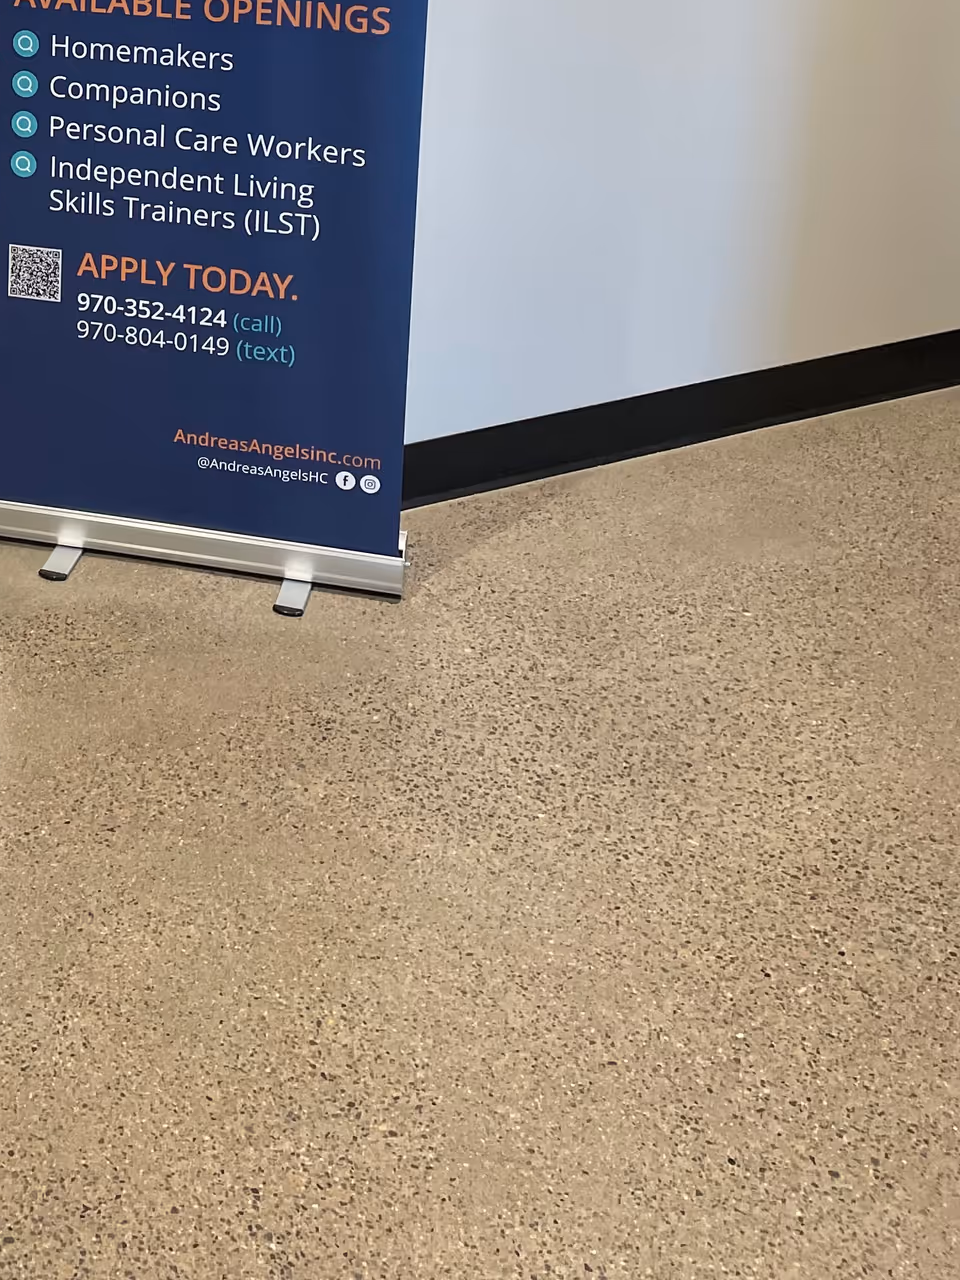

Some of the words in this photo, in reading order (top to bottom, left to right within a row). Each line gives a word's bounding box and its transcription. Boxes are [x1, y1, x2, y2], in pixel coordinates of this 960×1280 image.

[51, 34, 234, 71] Homemakers
[49, 75, 221, 112] Companions
[49, 116, 166, 148] Personal
[174, 127, 239, 155] Care
[246, 133, 367, 168] Workers
[50, 156, 224, 195] Independent
[233, 173, 315, 209] Living
[49, 189, 115, 217] Skills
[123, 196, 236, 230] Trainers
[243, 209, 321, 242] (ILST)
[77, 252, 176, 286] APPLY
[183, 263, 299, 301] TODAY.
[76, 292, 227, 328] 970-352-4124
[232, 312, 282, 338] (call)
[76, 320, 230, 357] 970-804-0149
[236, 340, 296, 368] (text)
[173, 428, 381, 471] AndreasAngelsinc.com
[197, 456, 329, 486] @AndreasAngelsHC
